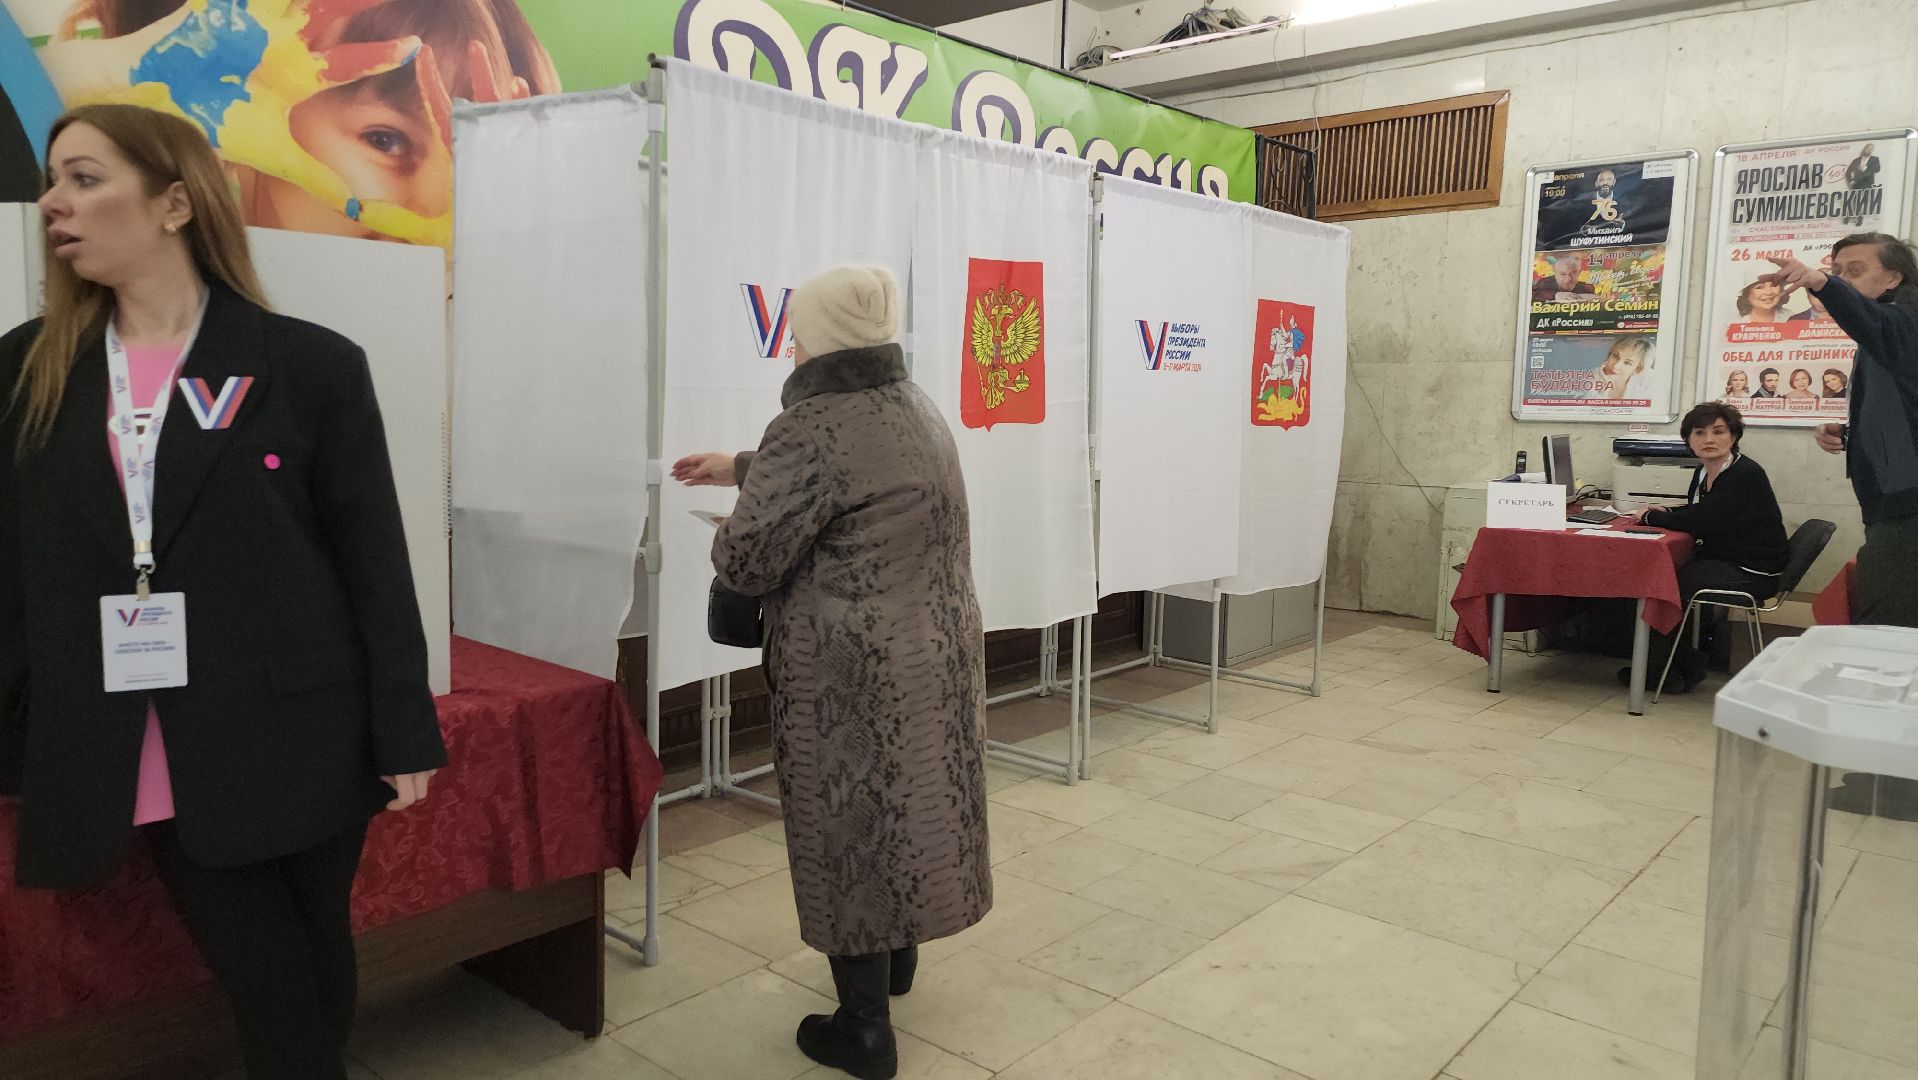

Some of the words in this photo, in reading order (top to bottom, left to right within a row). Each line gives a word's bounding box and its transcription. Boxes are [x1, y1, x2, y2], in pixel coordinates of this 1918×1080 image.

[1737, 153, 1747, 162] 18
[1752, 150, 1797, 161] АПРЕЛЯ
[1736, 163, 1823, 195] ЯРОСЛАВ
[1732, 184, 1883, 224] СУМИШЕВСКИЙ
[1570, 233, 1633, 246] ШУФУТИНСКИЙ
[1588, 253, 1604, 267] 14
[1731, 249, 1750, 261] 26
[1756, 249, 1794, 260] МАРТА
[1532, 299, 1600, 315] Валерий
[1171, 323, 1200, 334] ВЫБОРЫ
[1536, 318, 1550, 328] ДК
[1167, 336, 1206, 348] ПРЕЗИДЕНТА
[1165, 350, 1191, 360] РОССИИ
[1723, 351, 1753, 362] ОБЕД
[1757, 350, 1783, 362] ДЛЯ
[1789, 348, 1856, 361] ГРЕШНИКО
[1532, 370, 1595, 380] ТАТЬЯНА
[1531, 380, 1614, 391] БУЛАНОВА
[1498, 498, 1555, 507] СЕКРЕТАРЬ
